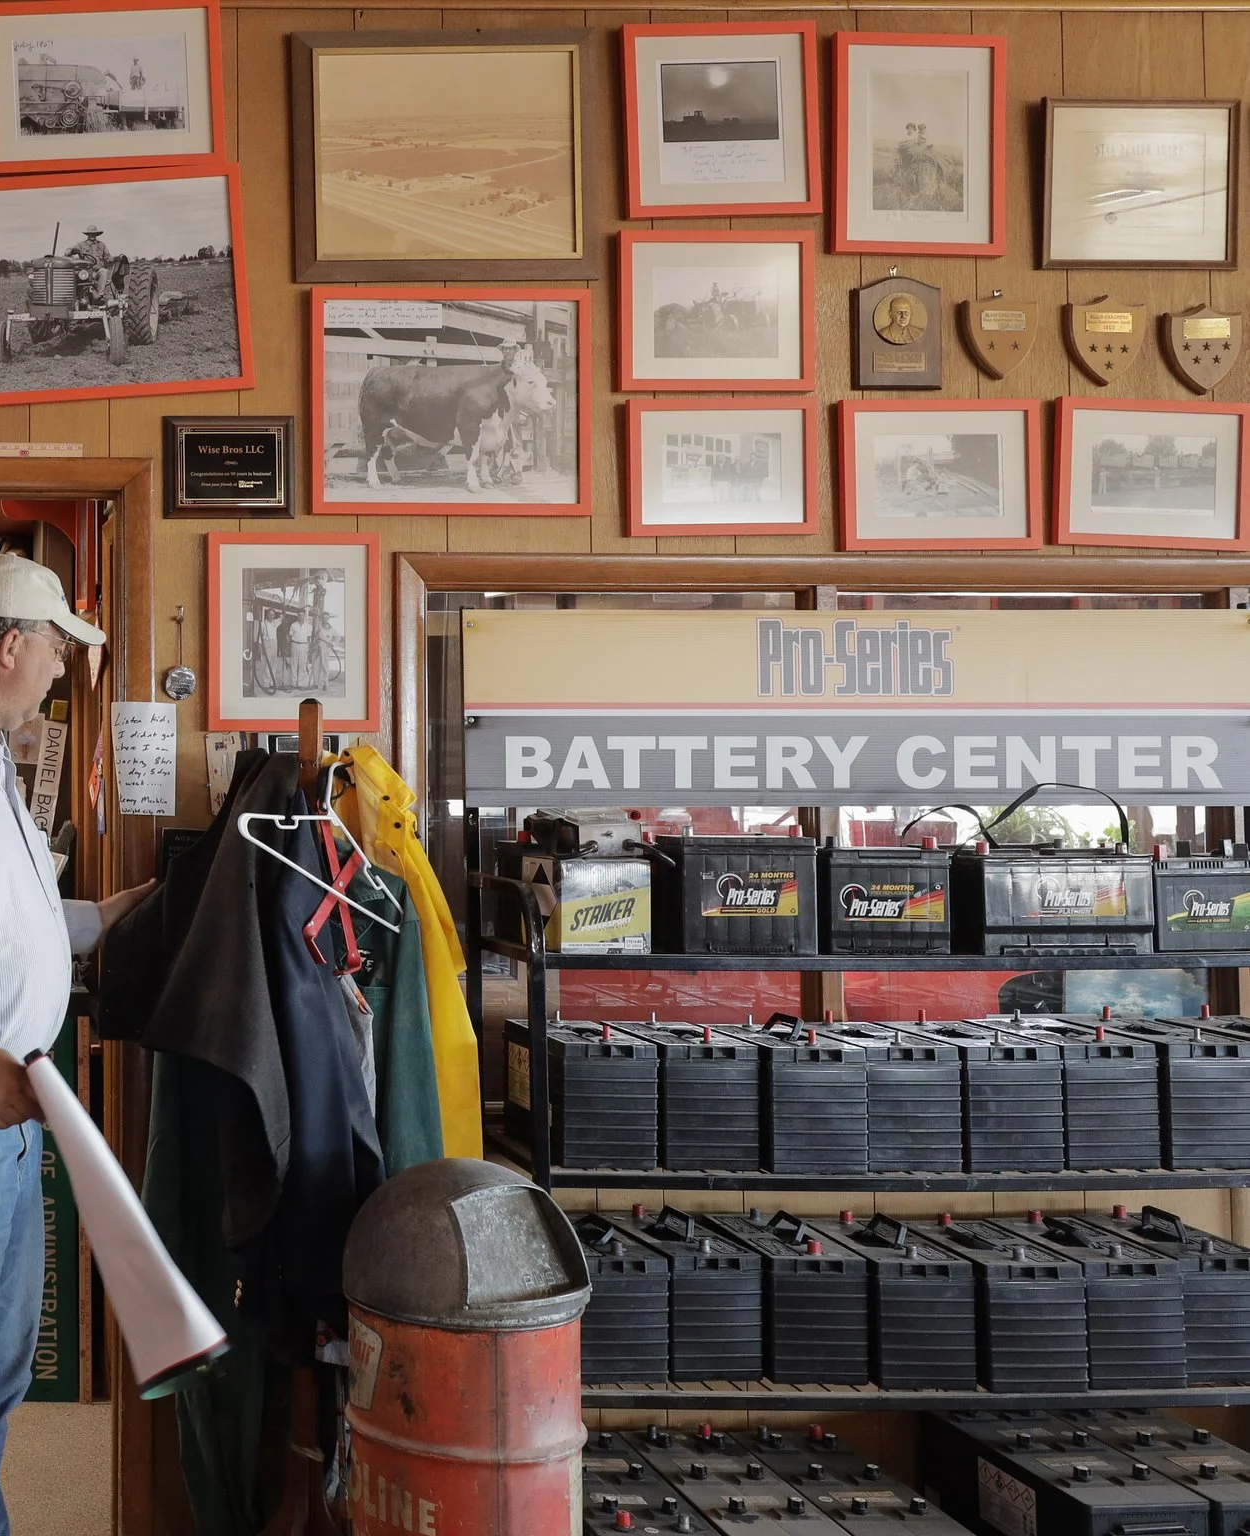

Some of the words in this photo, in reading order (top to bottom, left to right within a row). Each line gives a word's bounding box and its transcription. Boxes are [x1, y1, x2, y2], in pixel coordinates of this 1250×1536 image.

[198, 445, 221, 454] Wise
[222, 445, 243, 454] Bros
[245, 445, 264, 454] LLC
[756, 617, 955, 698] Pro-Series
[114, 712, 142, 727] Listen
[117, 730, 125, 739] I
[161, 732, 175, 741] got
[39, 727, 62, 787] DANIEL
[142, 744, 150, 752] I
[504, 735, 870, 790] BATTERY
[896, 734, 1222, 790] CENTER
[726, 888, 777, 905] Pro-Series
[1044, 890, 1093, 907] Pro-Series
[570, 897, 636, 932] STRIKER
[849, 898, 902, 917] Pro-Series
[1190, 901, 1231, 917] Pro-Series
[40, 1151, 56, 1179] OF
[35, 1198, 58, 1381] ADMINISTRATION
